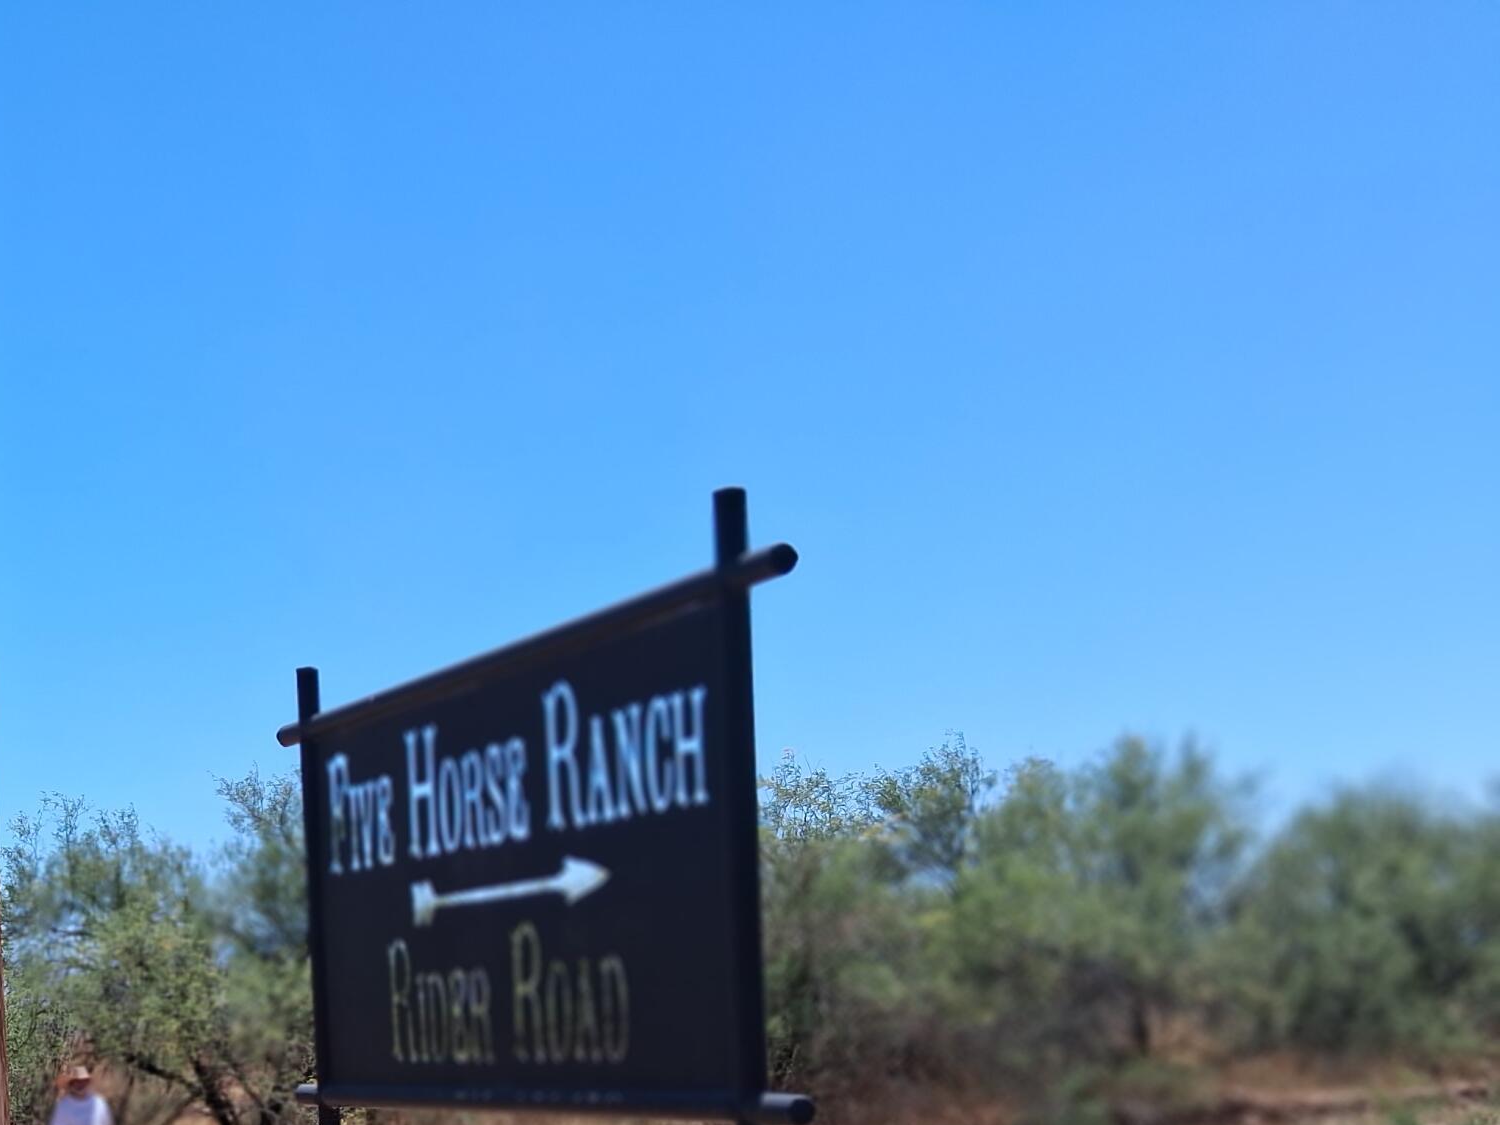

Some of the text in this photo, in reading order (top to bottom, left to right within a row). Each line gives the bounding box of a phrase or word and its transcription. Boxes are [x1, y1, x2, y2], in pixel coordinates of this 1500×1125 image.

[326, 679, 710, 875] FIVE HORSE RANCH
[387, 919, 629, 1065] RIDER ROAD
